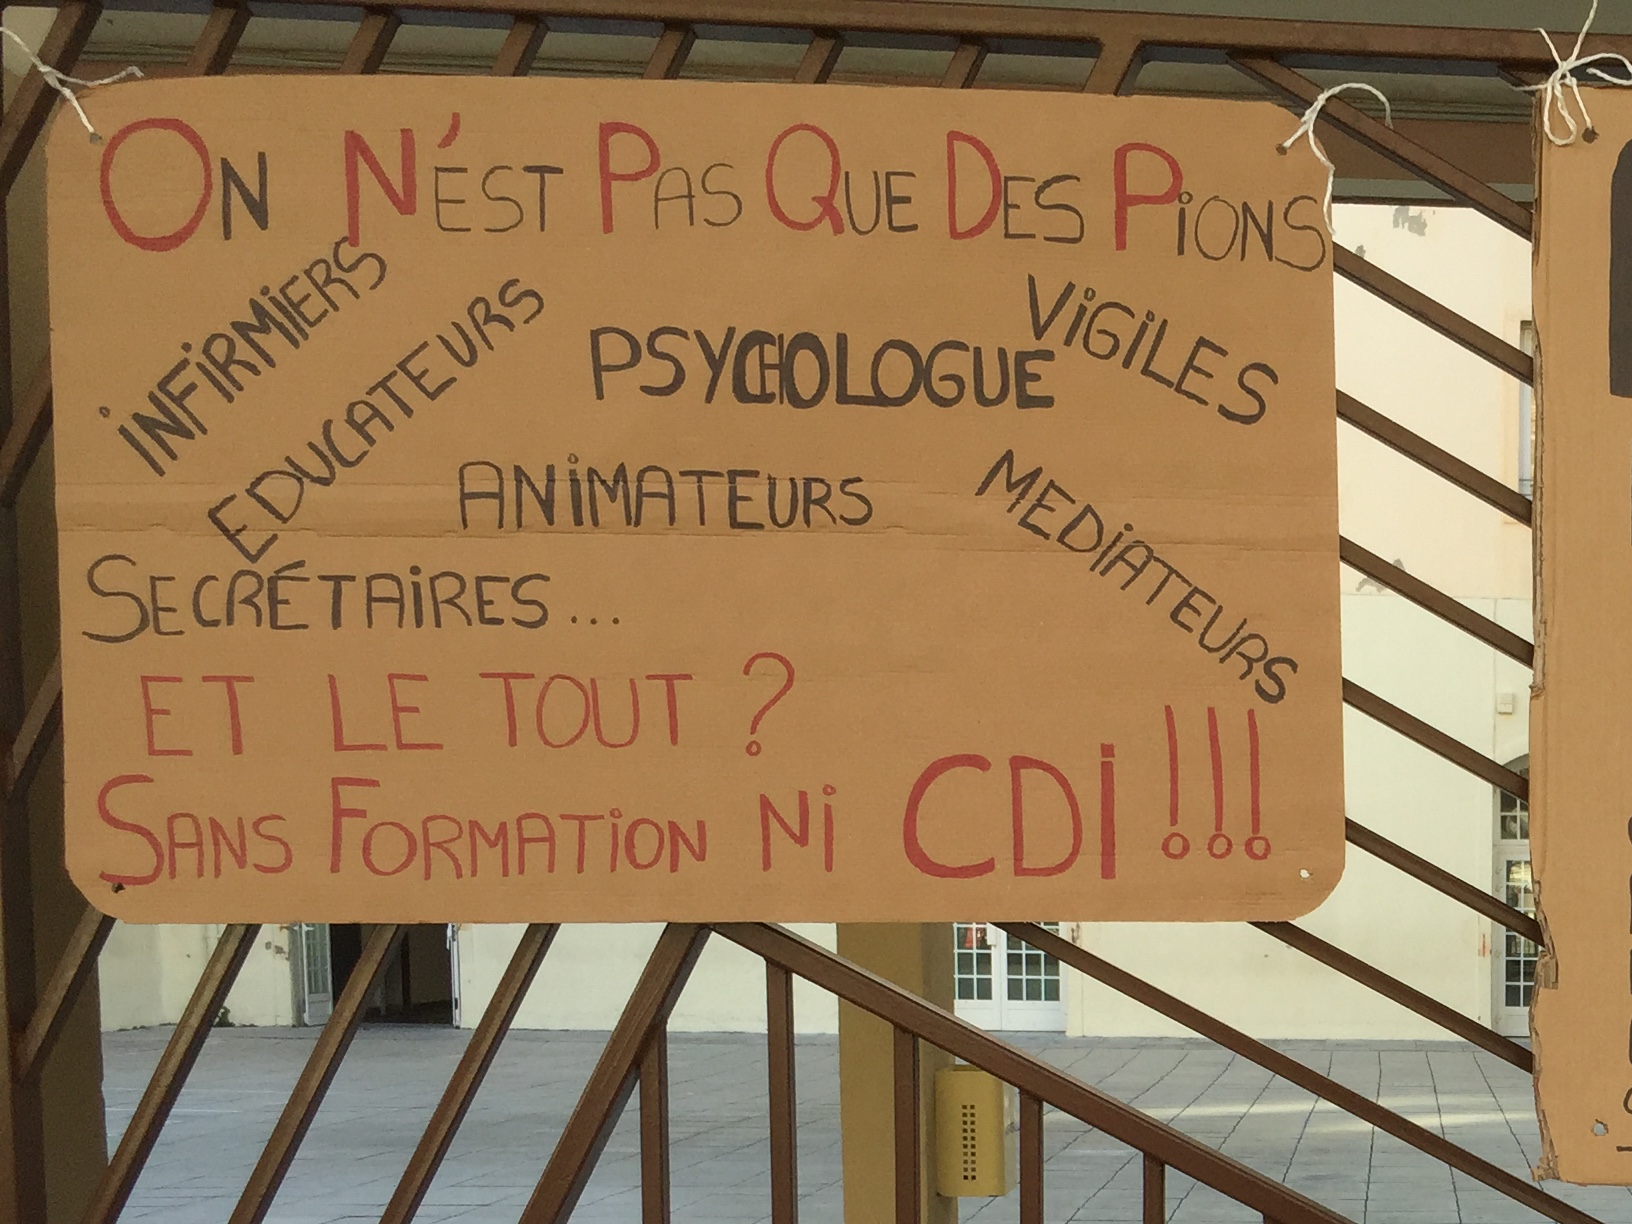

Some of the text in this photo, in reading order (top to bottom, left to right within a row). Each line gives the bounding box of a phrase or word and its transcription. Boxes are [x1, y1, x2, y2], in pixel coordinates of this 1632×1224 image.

[101, 117, 269, 252] ON
[600, 121, 743, 236] PAS
[765, 123, 918, 236] QUE
[946, 130, 1085, 243] DES
[208, 278, 545, 562] EDUCATEURS
[589, 326, 1056, 410] PSYCHOLOGUE
[141, 652, 796, 756] ET LE TOUT ?
[98, 774, 294, 886] SANS
